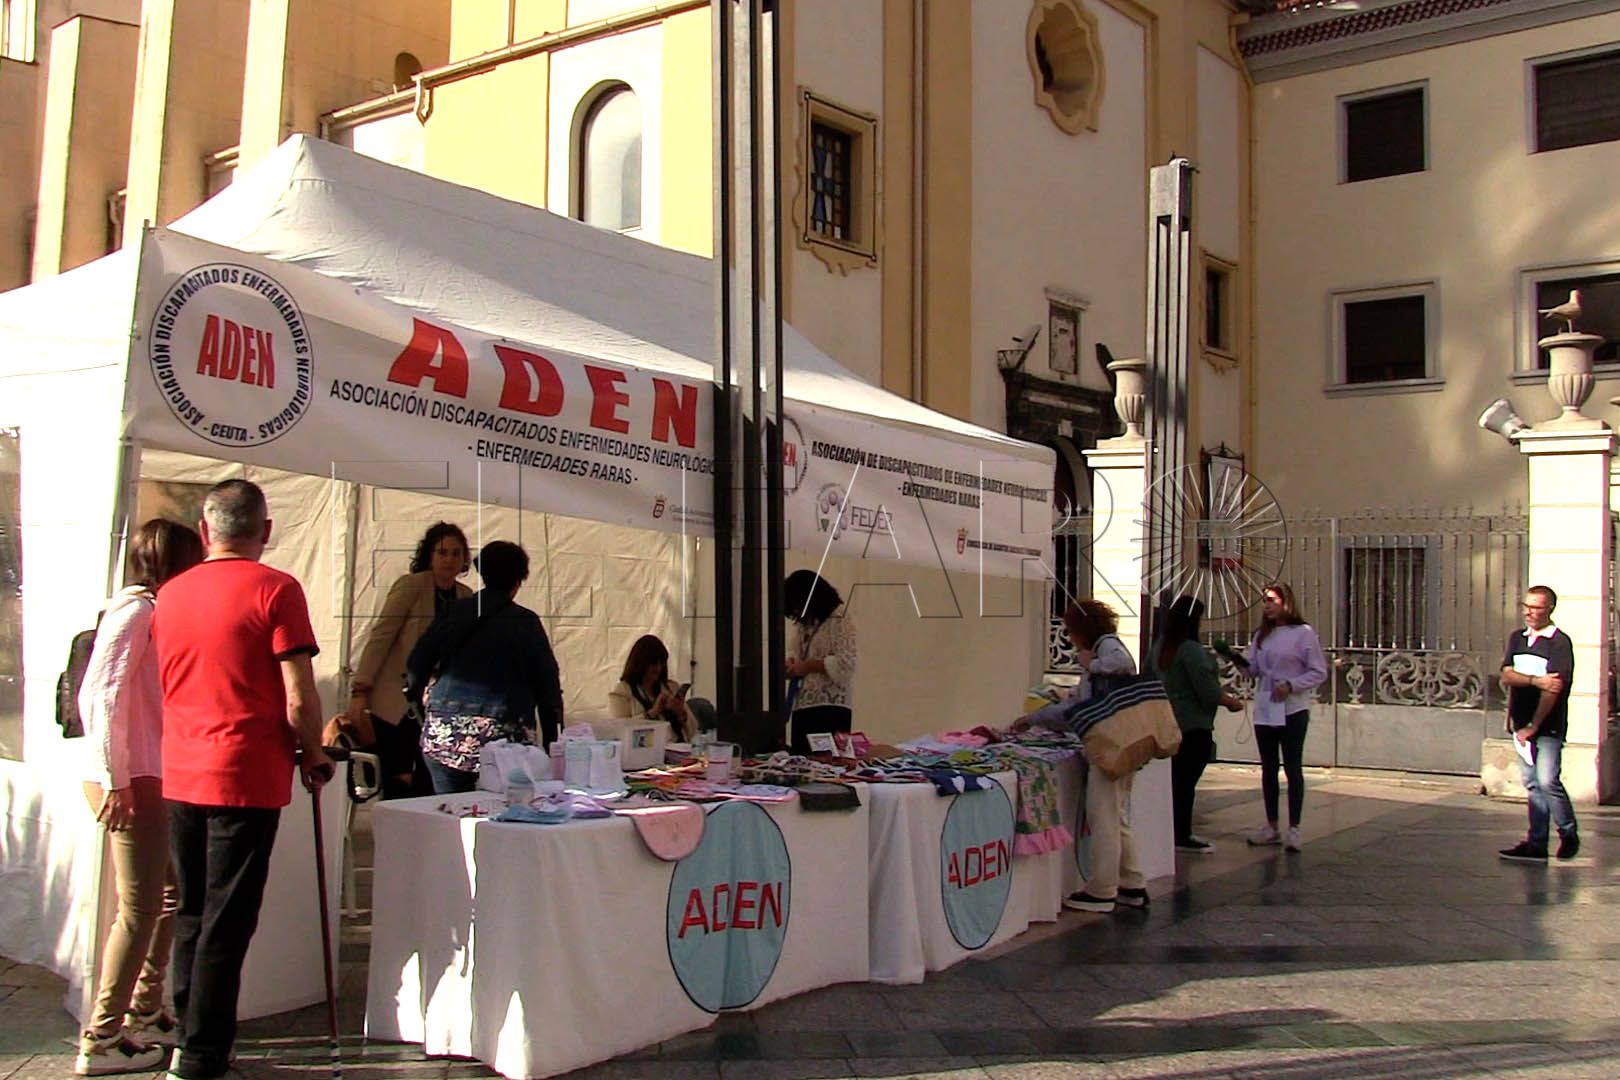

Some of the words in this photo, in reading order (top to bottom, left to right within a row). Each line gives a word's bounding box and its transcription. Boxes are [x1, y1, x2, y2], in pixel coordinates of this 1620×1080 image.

[155, 268, 239, 340] DISCAPACITADOS
[241, 273, 308, 354] ENFERMEDADES
[152, 343, 204, 426] ASOCIACIÓN
[196, 314, 276, 389] ADEN
[386, 317, 699, 449] ADEN
[210, 423, 248, 443] CEUTA
[330, 379, 429, 417] ASOCIACIÓN
[431, 400, 558, 445] DISCAPACITADOS
[559, 428, 650, 463] ENFERMEDADES
[476, 439, 589, 476] ENFERMEDADES
[589, 462, 633, 486] RARAS
[811, 440, 866, 466] ASOCIACIÓN
[866, 452, 878, 469] DE
[944, 468, 953, 484] DE
[948, 839, 1011, 889] ADEN
[677, 881, 783, 939] ADEN
